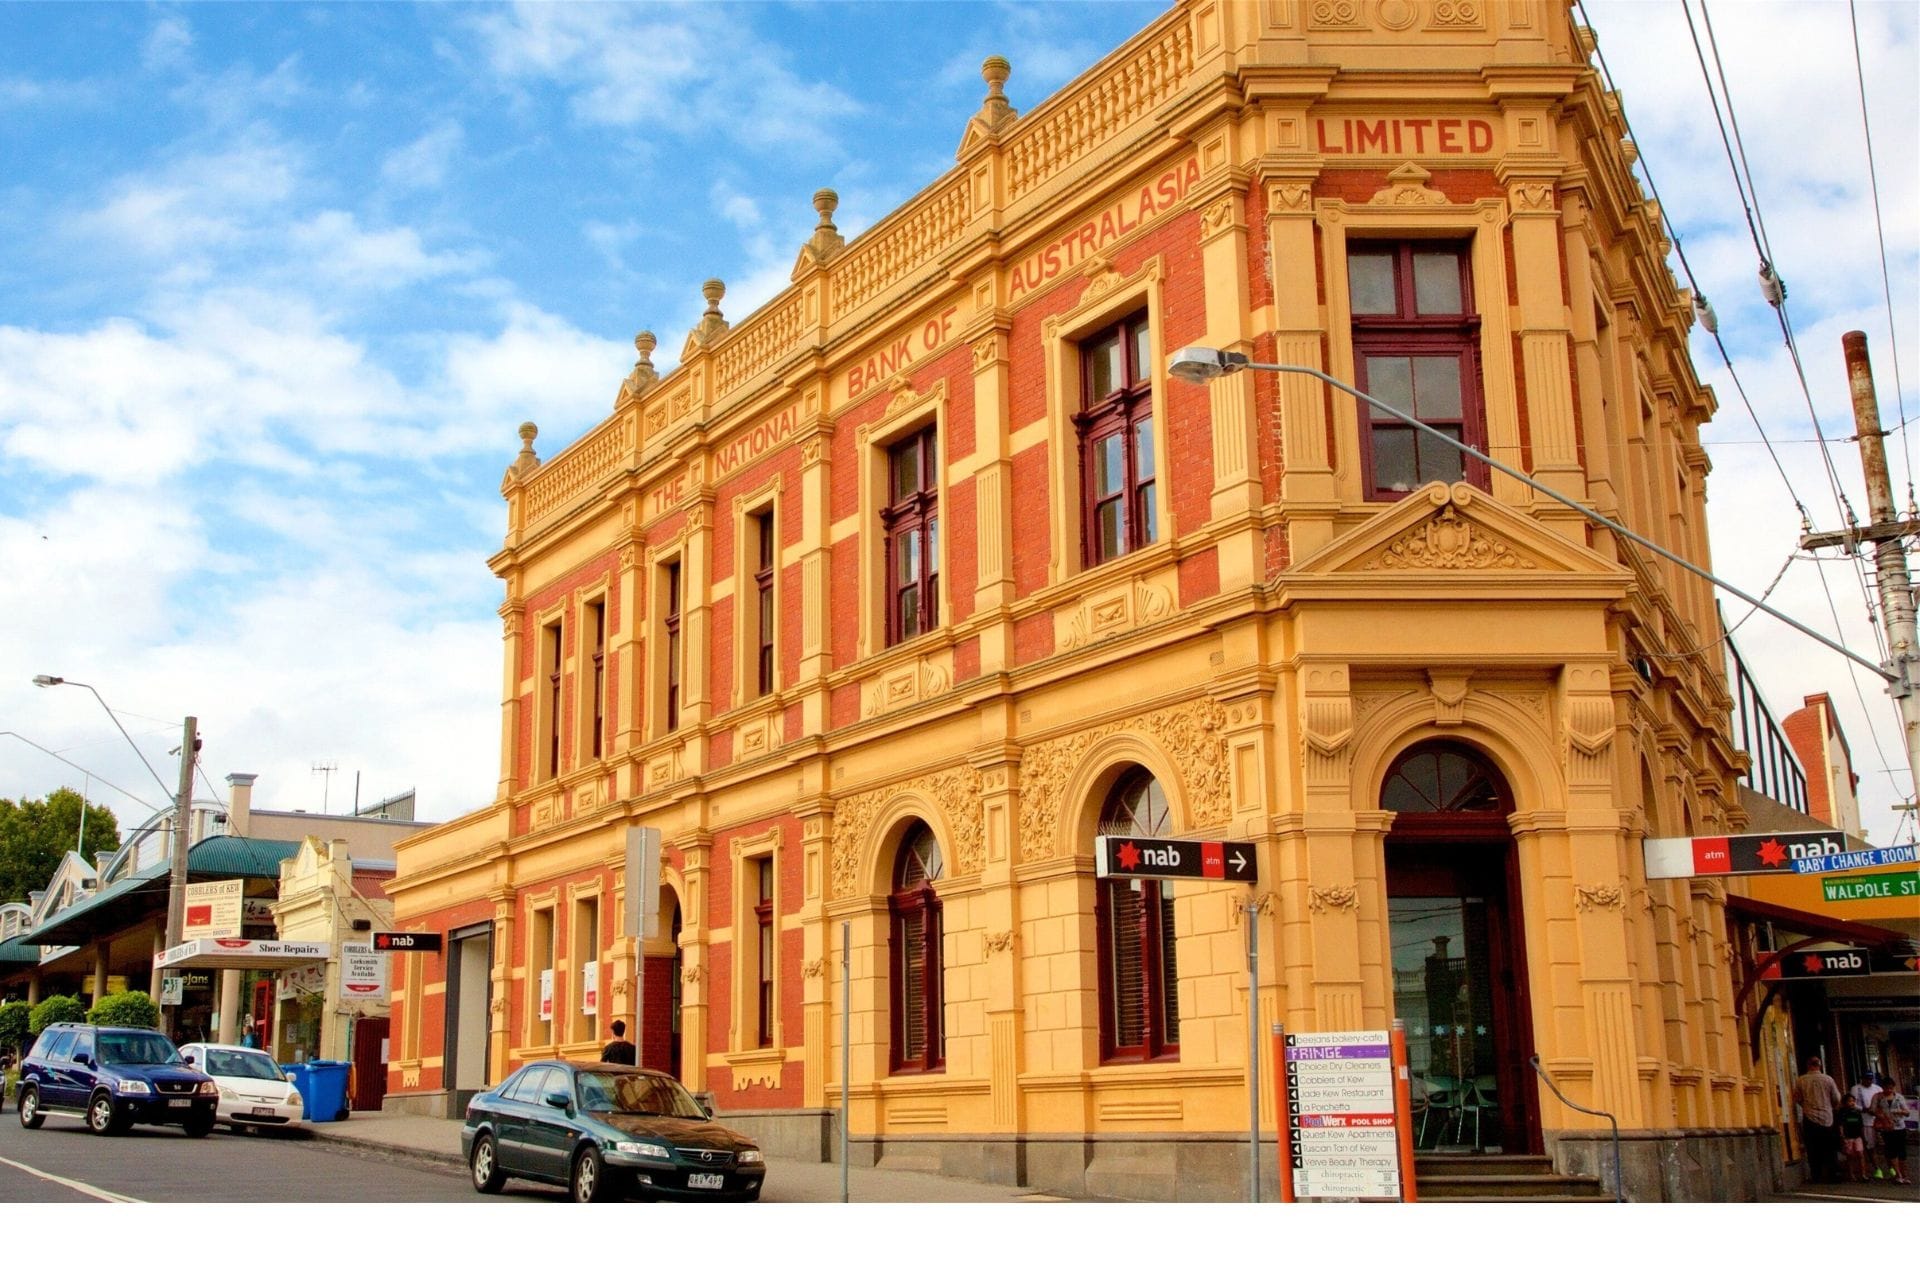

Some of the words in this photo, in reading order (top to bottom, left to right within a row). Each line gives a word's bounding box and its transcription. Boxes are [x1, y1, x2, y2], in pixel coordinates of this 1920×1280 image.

[1316, 118, 1494, 155] LIMITED
[652, 474, 686, 514] THE
[847, 333, 913, 399] BANK
[923, 305, 958, 351] OF
[1009, 156, 1201, 303] AUSTRALASIA
[1704, 850, 1725, 860] atm
[1789, 837, 1840, 860] nab
[1143, 845, 1181, 867] nab
[1205, 856, 1221, 865] atm
[1798, 858, 1826, 873] BABY
[1832, 851, 1877, 869] CHANGE
[1881, 847, 1914, 863] ROOM
[1825, 882, 1892, 900] WALPOLE
[1901, 880, 1917, 895] ST
[392, 935, 414, 946] nab
[259, 943, 281, 952] Shoe
[284, 944, 320, 955] Repairs
[1826, 953, 1862, 969] nab
[1291, 1046, 1342, 1060] FRINGE
[1299, 1062, 1328, 1071] Choice
[1329, 1062, 1343, 1071] Dry
[1345, 1061, 1381, 1070] Cleaners
[1299, 1076, 1335, 1085] Cobblers
[1337, 1075, 1345, 1084] of
[1347, 1075, 1365, 1084] Kew
[1300, 1089, 1320, 1098] Jade
[1322, 1089, 1339, 1097] Kew
[1341, 1089, 1384, 1097] Restaurant
[1300, 1103, 1310, 1112] La
[1311, 1103, 1351, 1112] Porchetta
[1303, 1114, 1347, 1127] PoolWerx
[1351, 1118, 1371, 1126] POOL
[1302, 1130, 1326, 1139] Quest
[1327, 1130, 1345, 1138] Kew
[1348, 1130, 1395, 1139] Apartments
[1303, 1144, 1332, 1153] Tuscan
[1333, 1144, 1348, 1152] Tan
[1350, 1144, 1359, 1152] of
[1360, 1144, 1378, 1152] Kew
[1303, 1158, 1327, 1167] Verve
[1328, 1158, 1357, 1167] Beauty
[1359, 1157, 1392, 1167] Therapy
[1321, 1169, 1365, 1180] chiropractic
[1321, 1183, 1366, 1193] chiropractic
